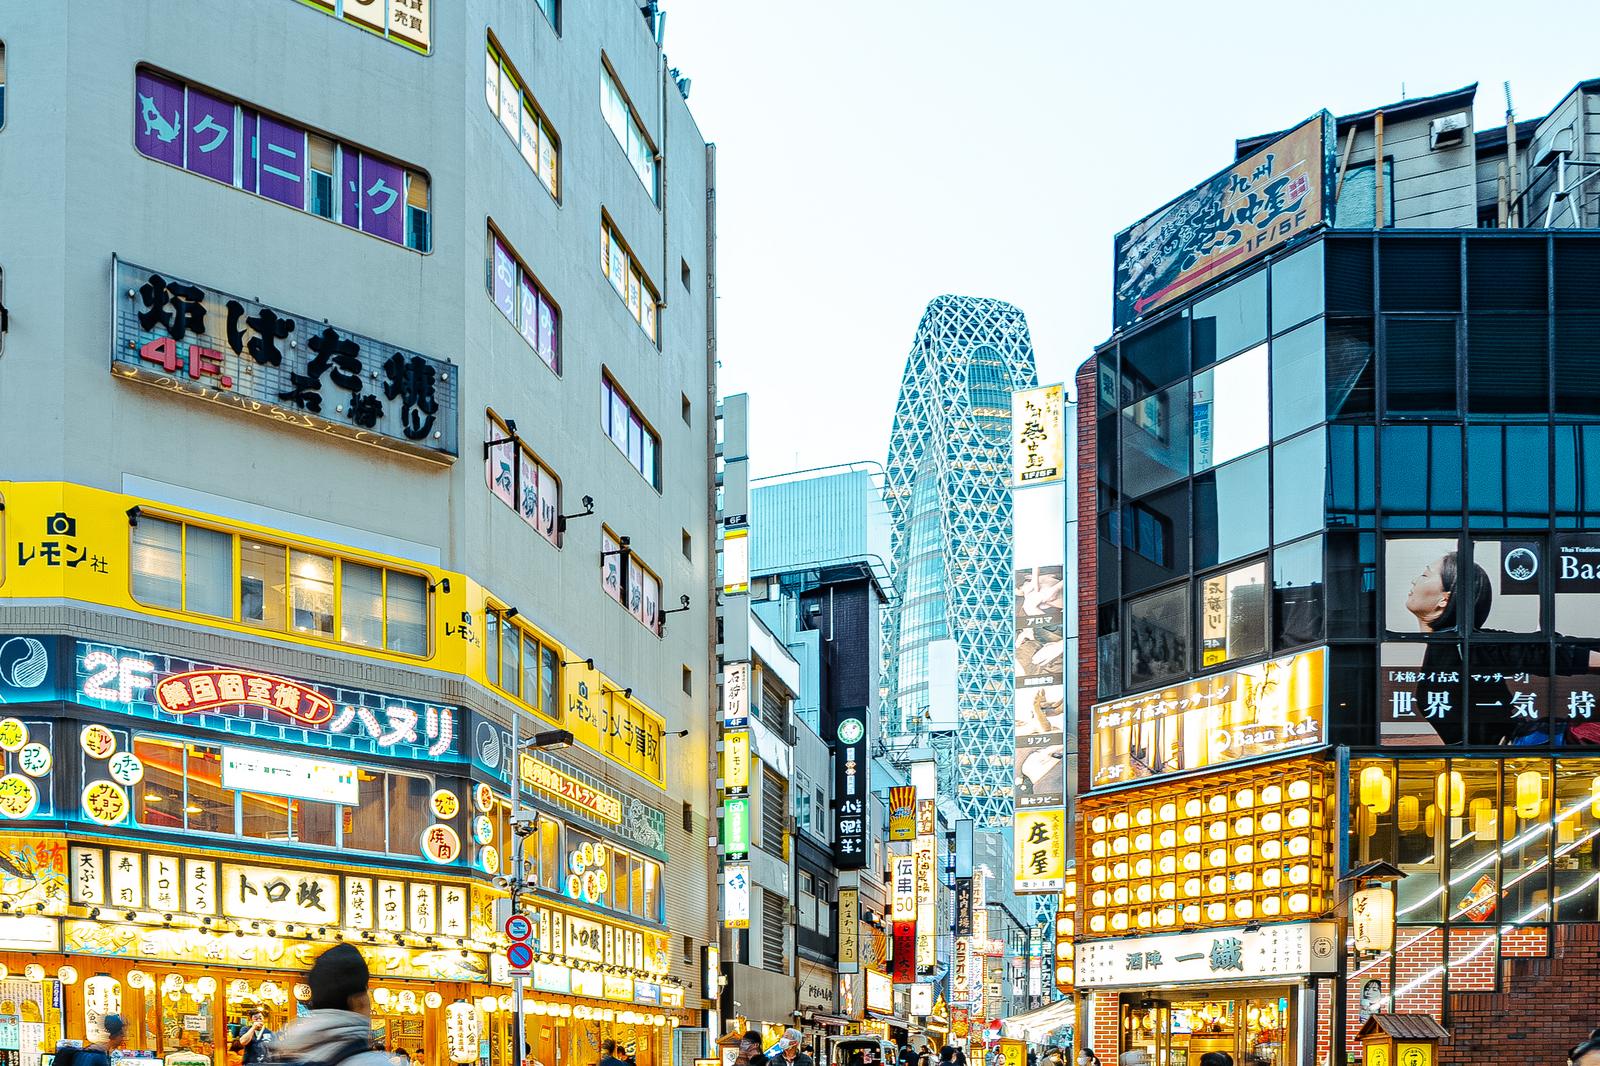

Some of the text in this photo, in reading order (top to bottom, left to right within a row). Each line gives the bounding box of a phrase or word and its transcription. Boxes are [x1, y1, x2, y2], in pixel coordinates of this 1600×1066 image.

[394, 9, 422, 33] 売買
[1246, 209, 1307, 252] 1F/5F
[729, 515, 741, 525] 6F
[18, 541, 109, 574] レモン社
[445, 622, 480, 648] レモン社
[1027, 616, 1053, 626] アロマ
[83, 652, 160, 704] 2F
[159, 674, 329, 719] 韓国個室横丁
[330, 705, 453, 757] ハヌリ
[731, 718, 742, 726] 4F
[1282, 715, 1319, 739] Rak
[430, 828, 452, 860] 焼肉
[839, 800, 857, 854] 小肥羊
[731, 852, 743, 860] 3F
[1027, 822, 1051, 875] 庄屋
[80, 853, 96, 899] 天ぷら
[117, 856, 133, 903] 寿司
[195, 867, 208, 909] まぐろ
[897, 859, 913, 894] 伝串
[896, 896, 914, 912] 50
[955, 941, 966, 984] カラオケ
